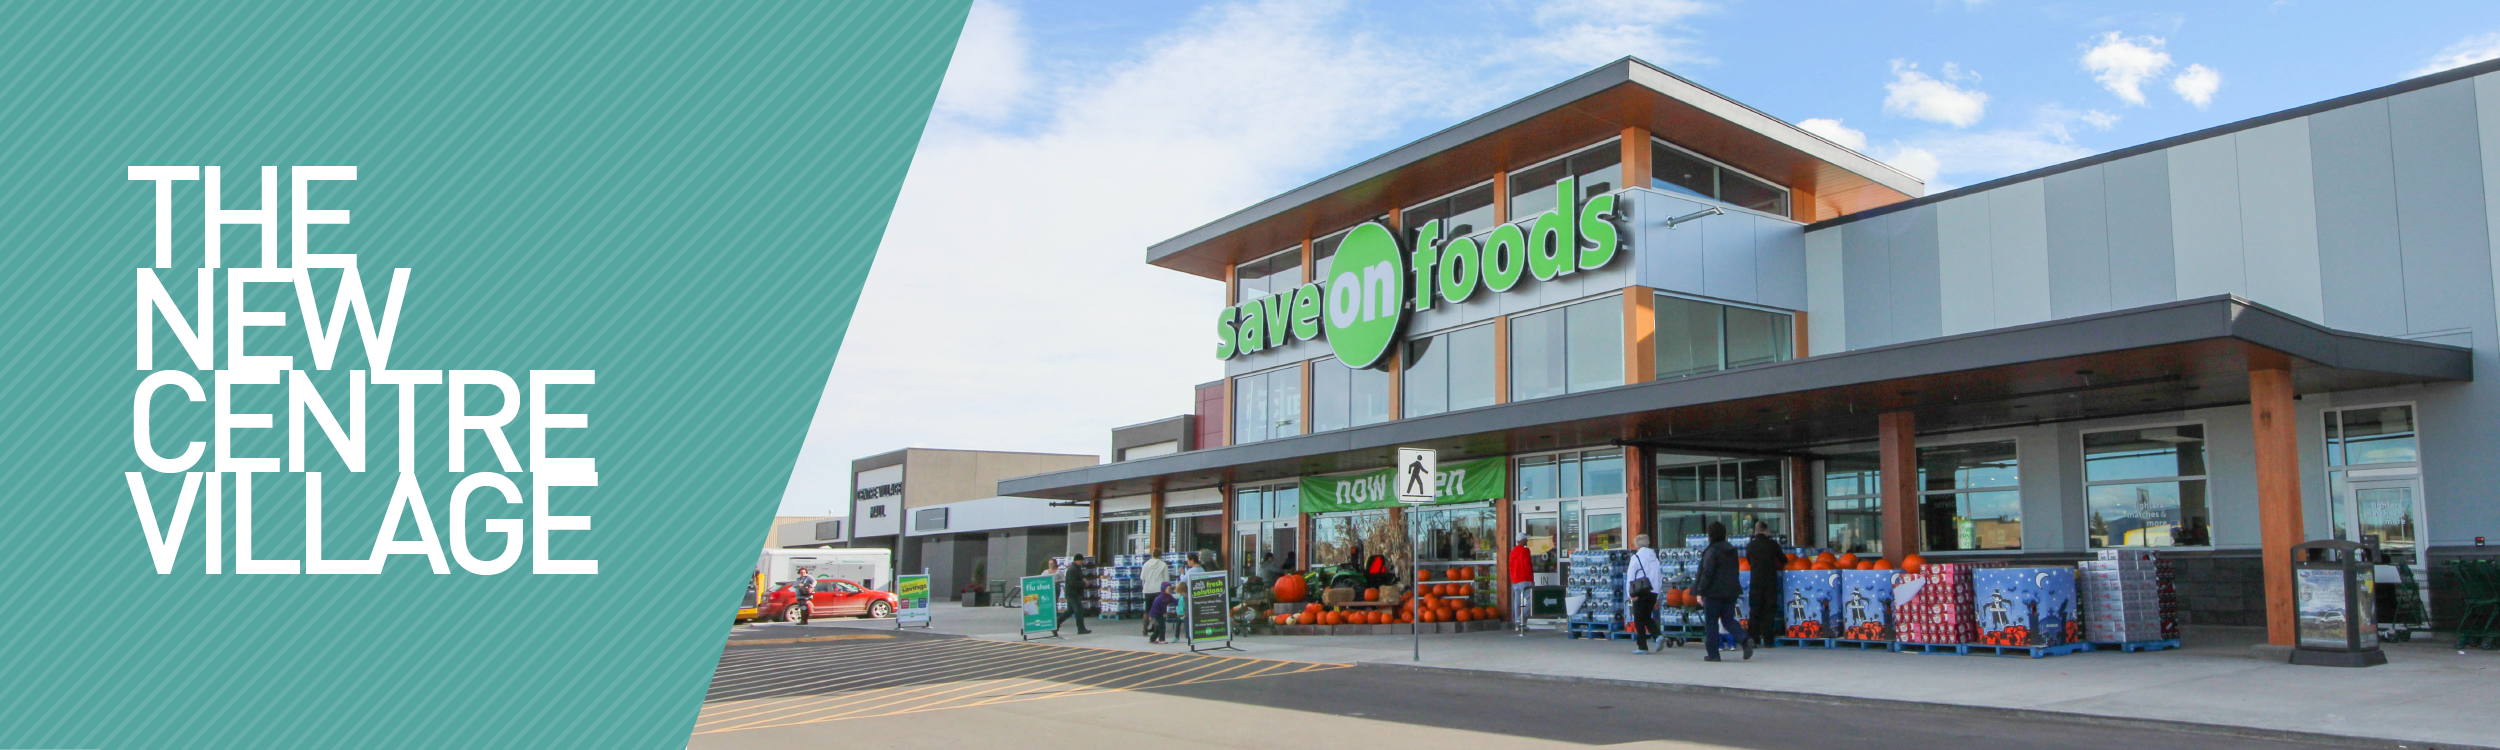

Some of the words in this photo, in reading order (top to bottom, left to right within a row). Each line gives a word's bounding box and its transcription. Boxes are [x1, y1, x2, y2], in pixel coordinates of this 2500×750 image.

[1216, 282, 1320, 361] save
[1329, 259, 1396, 330] on
[1411, 174, 1621, 313] foods
[1336, 474, 1386, 505] now
[1206, 580, 1224, 588] fresh
[1540, 576, 1549, 585] IN
[1193, 587, 1224, 597] solutions
